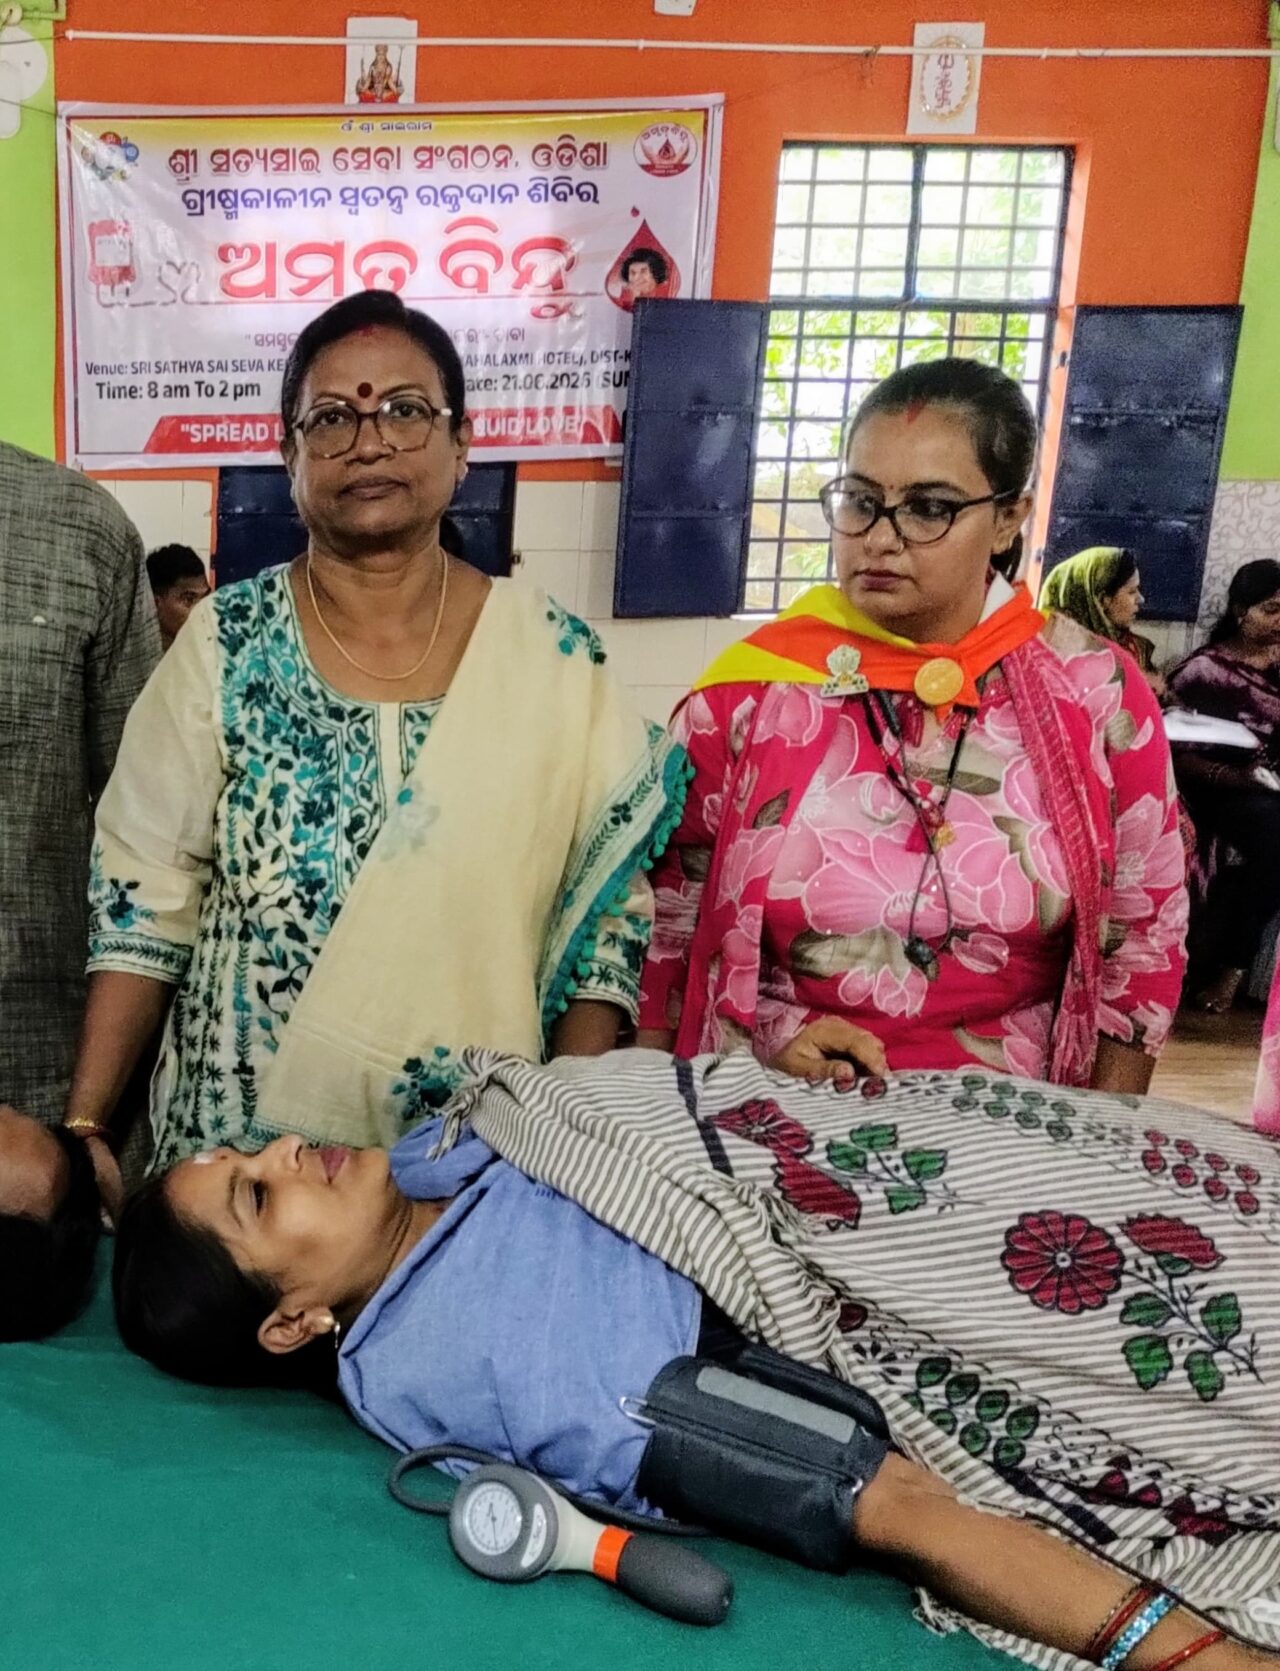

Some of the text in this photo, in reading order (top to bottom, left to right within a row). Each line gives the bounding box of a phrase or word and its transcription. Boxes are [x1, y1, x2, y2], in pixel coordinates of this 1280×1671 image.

[168, 148, 198, 182] ଶ୍ରୀ
[209, 147, 321, 174] ସତ୍ୟସାଇ
[332, 146, 401, 172] ସେବା
[415, 182, 520, 213] ରକ୍ତଦାନ
[526, 176, 600, 205] ଶିବିର
[85, 362, 128, 375] Venue:
[131, 361, 152, 375] SRI
[154, 360, 205, 374] SATHYA
[207, 359, 229, 373] SAI
[231, 359, 265, 372] SEVA
[96, 382, 143, 399] Time:
[147, 381, 158, 399] 8
[163, 384, 190, 398] am
[194, 380, 215, 397] To
[219, 380, 229, 397] 2
[233, 383, 261, 400] pm
[466, 377, 498, 392] ate:
[181, 422, 269, 443] "SPREAD
